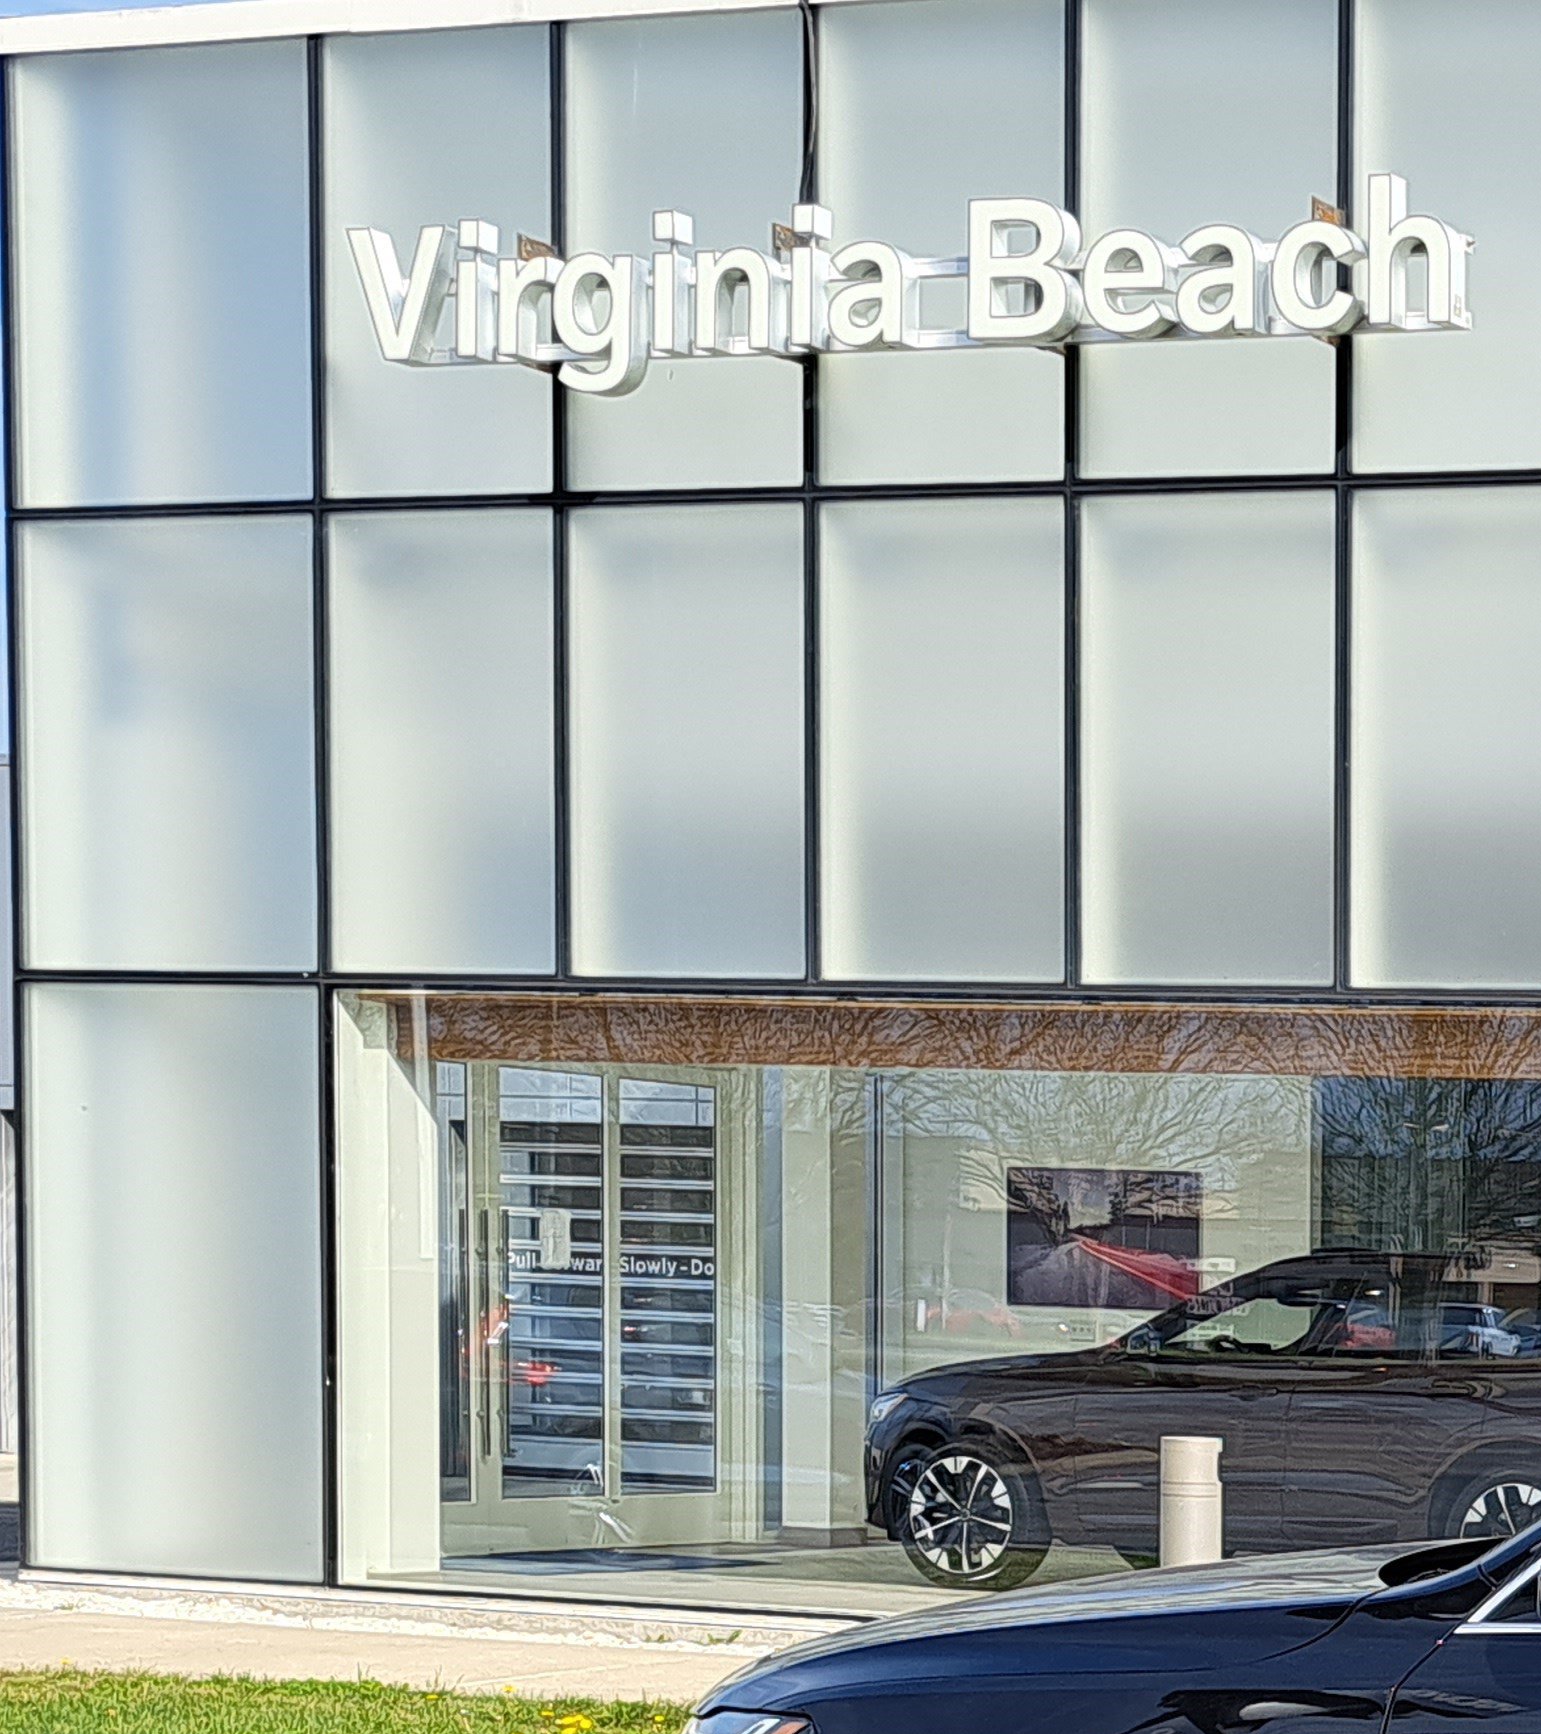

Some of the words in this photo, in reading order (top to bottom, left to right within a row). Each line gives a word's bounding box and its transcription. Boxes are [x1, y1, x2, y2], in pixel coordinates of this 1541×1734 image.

[346, 204, 908, 397] Virginia
[965, 173, 1470, 345] Beach
[620, 1256, 677, 1277] Slowly
